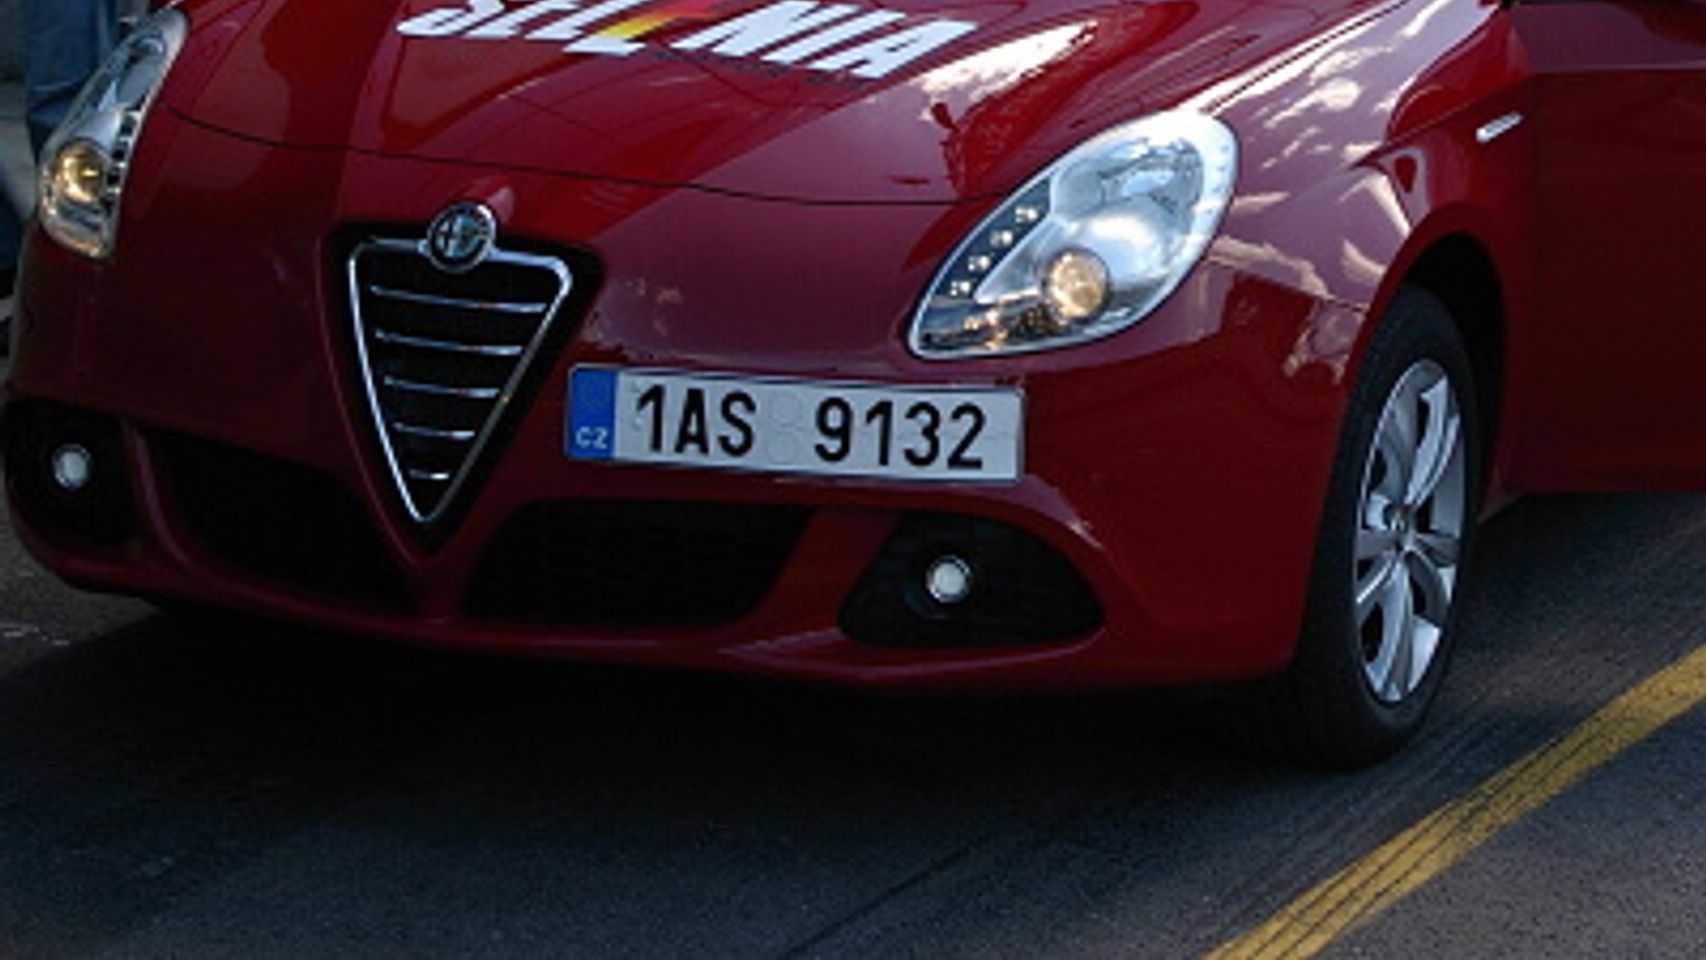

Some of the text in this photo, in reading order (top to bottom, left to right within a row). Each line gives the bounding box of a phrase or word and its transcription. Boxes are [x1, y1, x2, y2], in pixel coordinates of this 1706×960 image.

[575, 426, 608, 450] CZ
[636, 385, 986, 469] 1AS 9132
